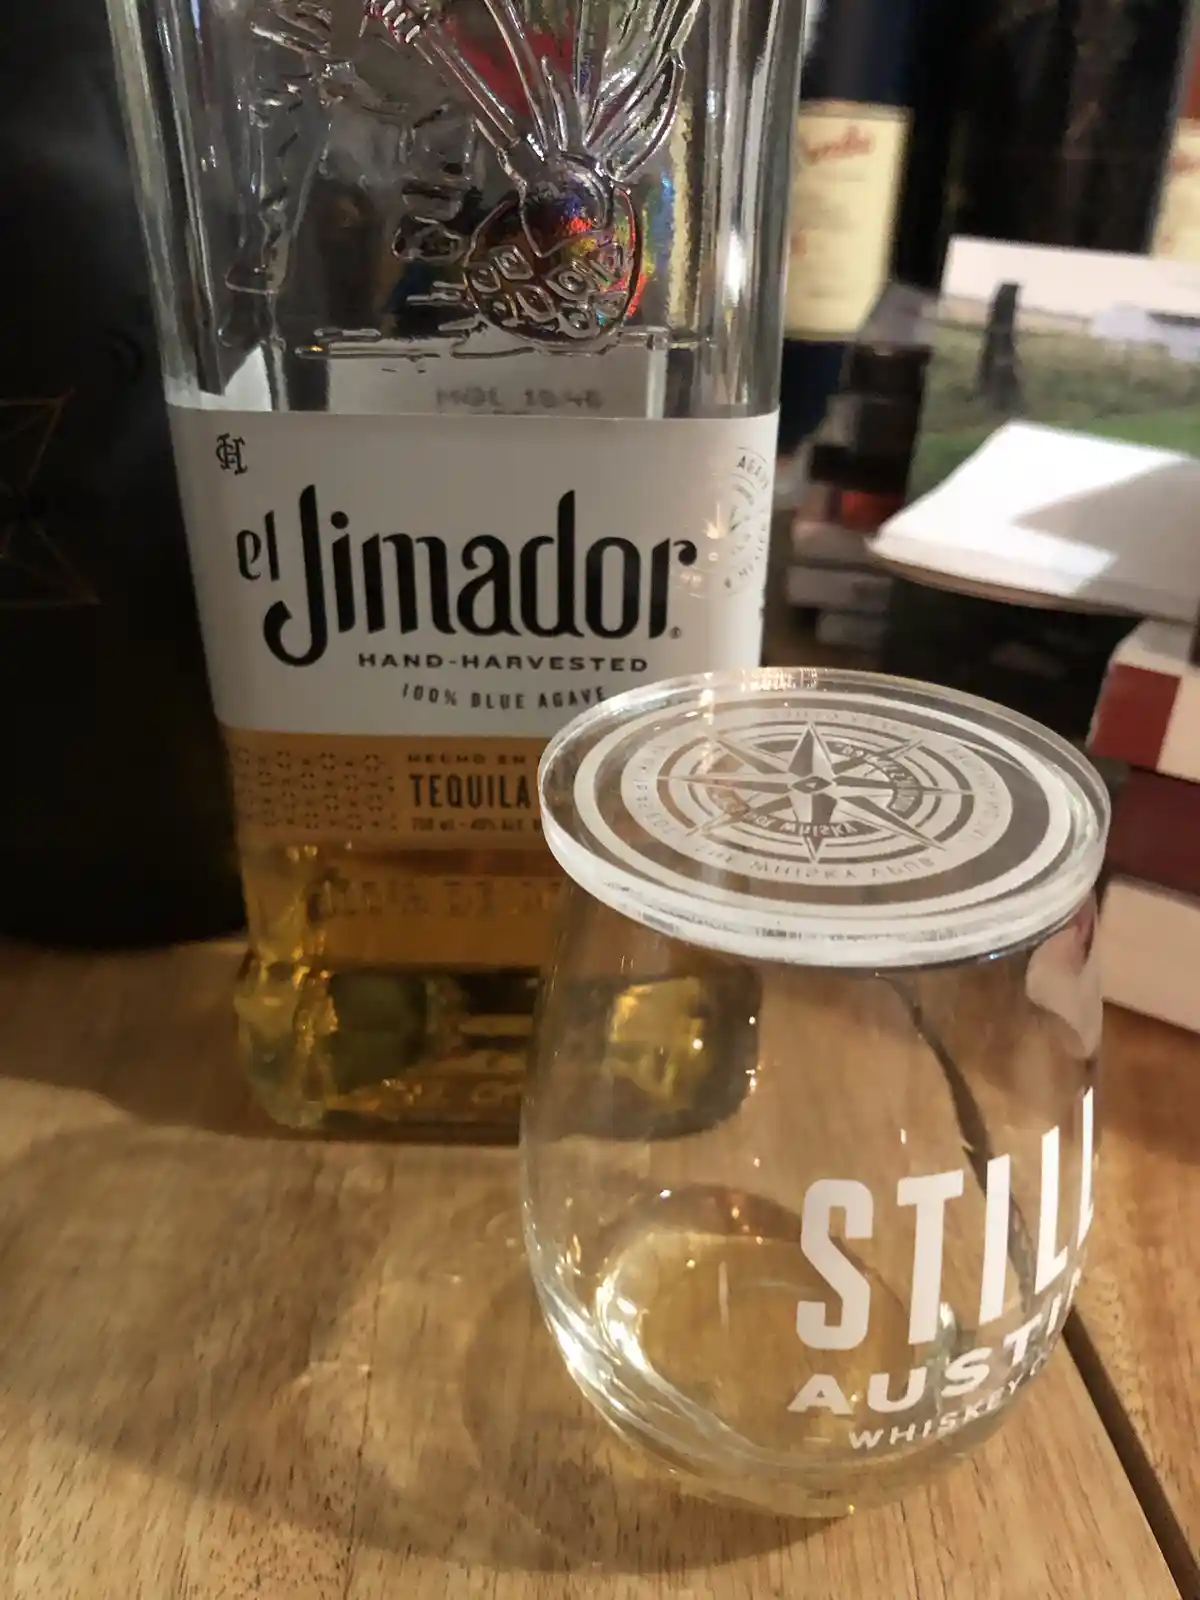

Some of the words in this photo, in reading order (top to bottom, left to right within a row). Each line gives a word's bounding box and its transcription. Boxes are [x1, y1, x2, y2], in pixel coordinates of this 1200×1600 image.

[263, 484, 698, 667] Jimador
[358, 653, 648, 672] HAND-HARVESTED
[403, 683, 457, 706] 100%
[471, 692, 525, 710] BLUE
[537, 686, 605, 708] AGAVE
[408, 773, 532, 809] TEQUILA
[796, 1086, 1093, 1350] STILL
